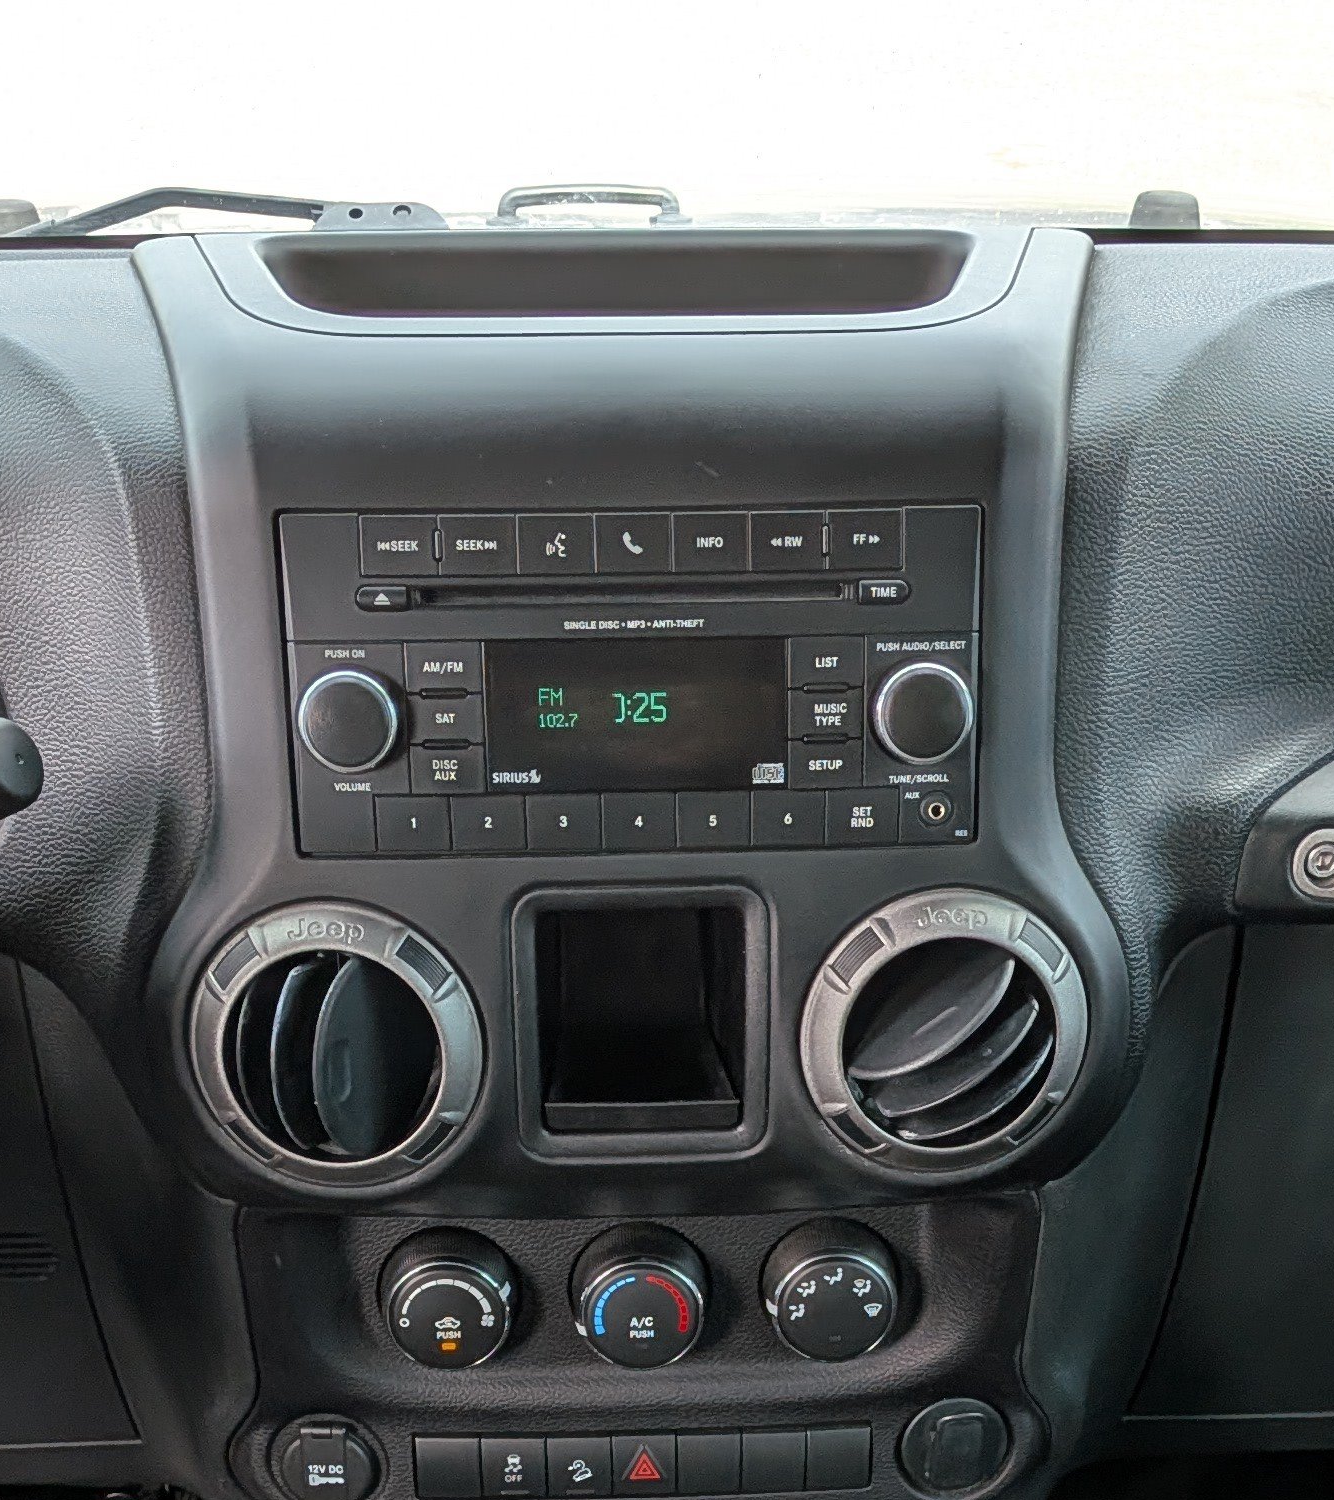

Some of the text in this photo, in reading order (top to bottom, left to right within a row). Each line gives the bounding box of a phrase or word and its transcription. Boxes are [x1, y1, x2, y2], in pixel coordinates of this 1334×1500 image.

[696, 537, 723, 548] INFO
[784, 536, 803, 547] RW
[853, 534, 866, 545] FF
[391, 541, 418, 552] SEEK
[456, 540, 483, 551] SEEK
[870, 587, 897, 598] TIME
[563, 619, 704, 630] SINGLE DISC MP3 ANTI-THEFT
[876, 640, 966, 652] PUSH AUDIO/SELECT
[324, 649, 365, 659] PUSH ON
[422, 662, 463, 674] AM/FM
[815, 657, 838, 669] LIST
[538, 687, 563, 707] FM
[814, 704, 847, 714] MUSIC
[435, 714, 455, 724] SAT
[539, 713, 578, 728] 102.7
[815, 716, 841, 727] TYPE
[432, 760, 458, 771] DISC
[808, 760, 843, 771] SETUP
[434, 772, 456, 782] AUX
[492, 773, 529, 784] SIRIUS
[889, 774, 950, 784] TUNE/SCROLL
[334, 783, 371, 793] VOLUME
[904, 791, 921, 800] AUX
[853, 807, 872, 816] SET
[411, 818, 417, 829] 1
[485, 817, 492, 829] 2
[559, 816, 568, 828] 3
[635, 816, 643, 827] 4
[709, 815, 717, 827] 5
[784, 814, 792, 825] 6
[851, 817, 874, 828] RND
[917, 906, 987, 930] Jeep
[286, 918, 365, 944] Jeep
[629, 1317, 654, 1328] A/C
[436, 1331, 462, 1339] PUSH
[629, 1330, 655, 1339] PUSH
[308, 1465, 326, 1474] 12V
[505, 1474, 523, 1483] OFF
